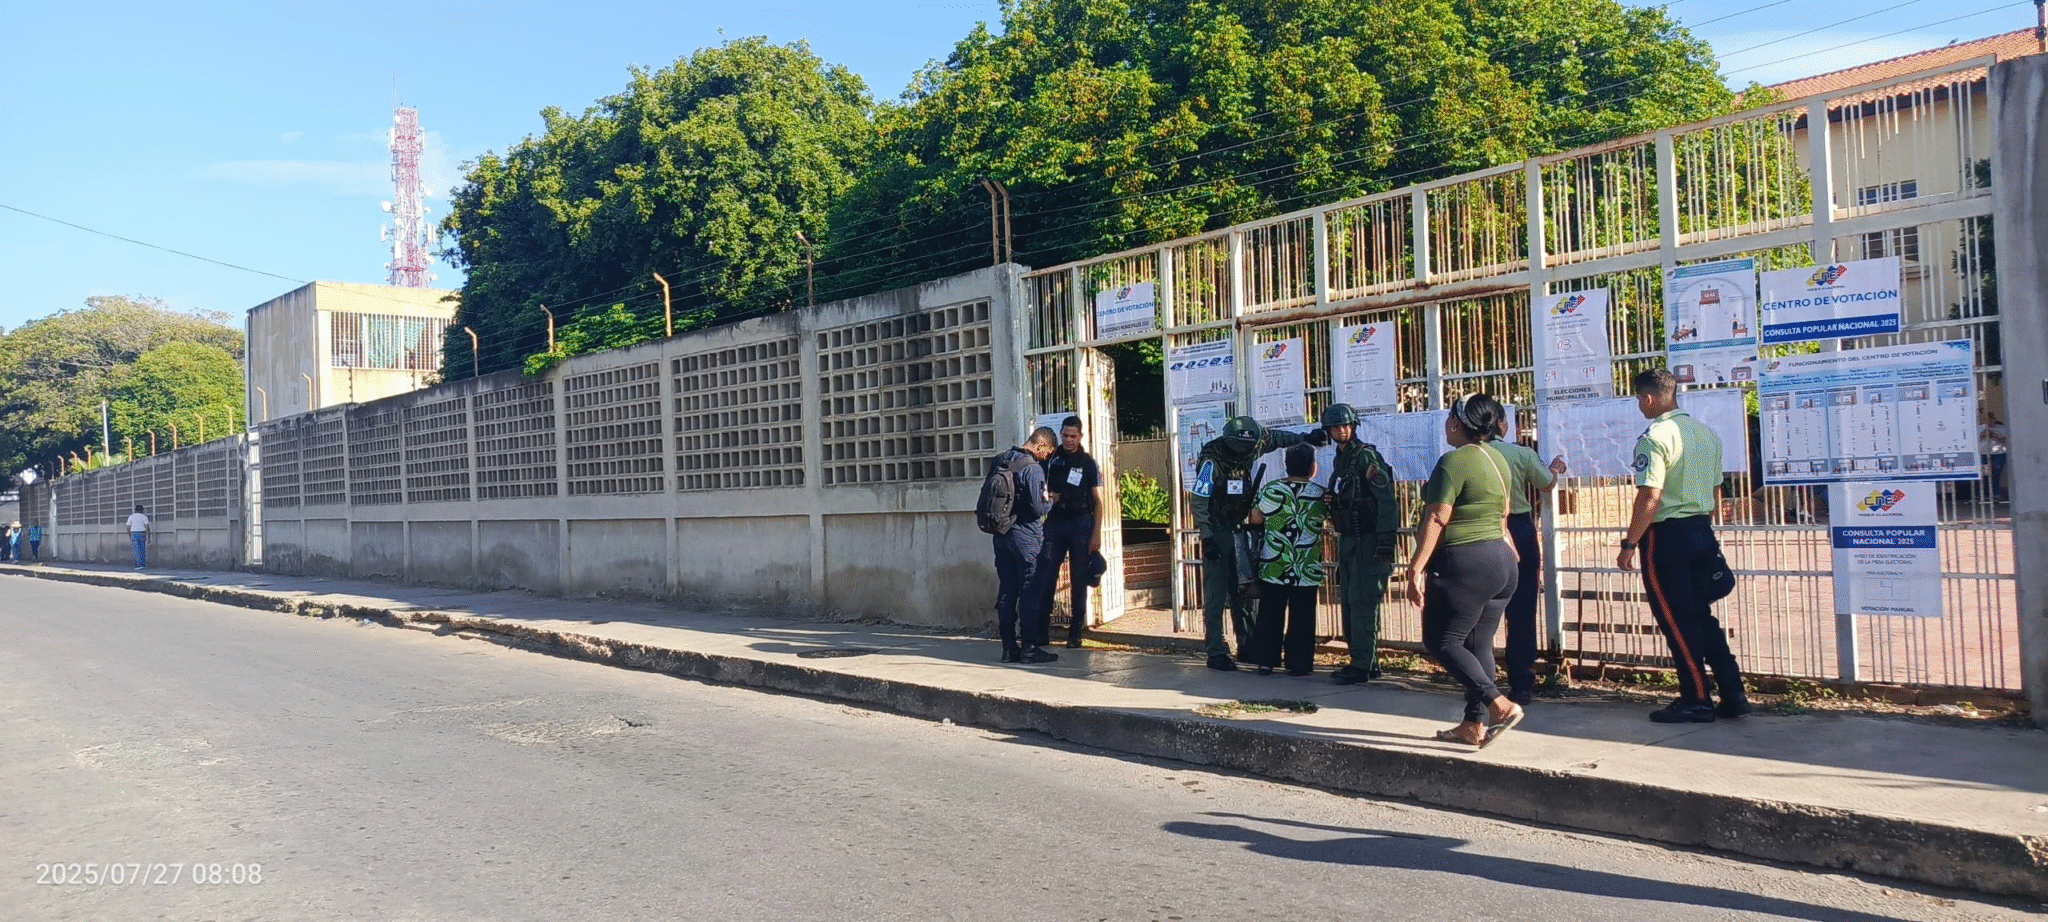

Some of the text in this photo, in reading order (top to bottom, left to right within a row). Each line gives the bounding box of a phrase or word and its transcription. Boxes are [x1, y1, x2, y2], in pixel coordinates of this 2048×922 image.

[1763, 289, 1898, 311] CENTRO DE VOTACIÓN
[1764, 327, 1801, 337] CONSULTA
[1802, 324, 1838, 334] POPULAR
[1838, 320, 1880, 331] NACIONAL
[1557, 338, 1571, 350] 03
[1788, 357, 1847, 367] FUNCIONAMIENTO
[1862, 353, 1890, 361] CENTRO
[1554, 387, 1591, 395] ELECCIONES
[1546, 393, 1586, 402] MUNICIPALES
[1842, 529, 1925, 537] CONSULTA POPULAR
